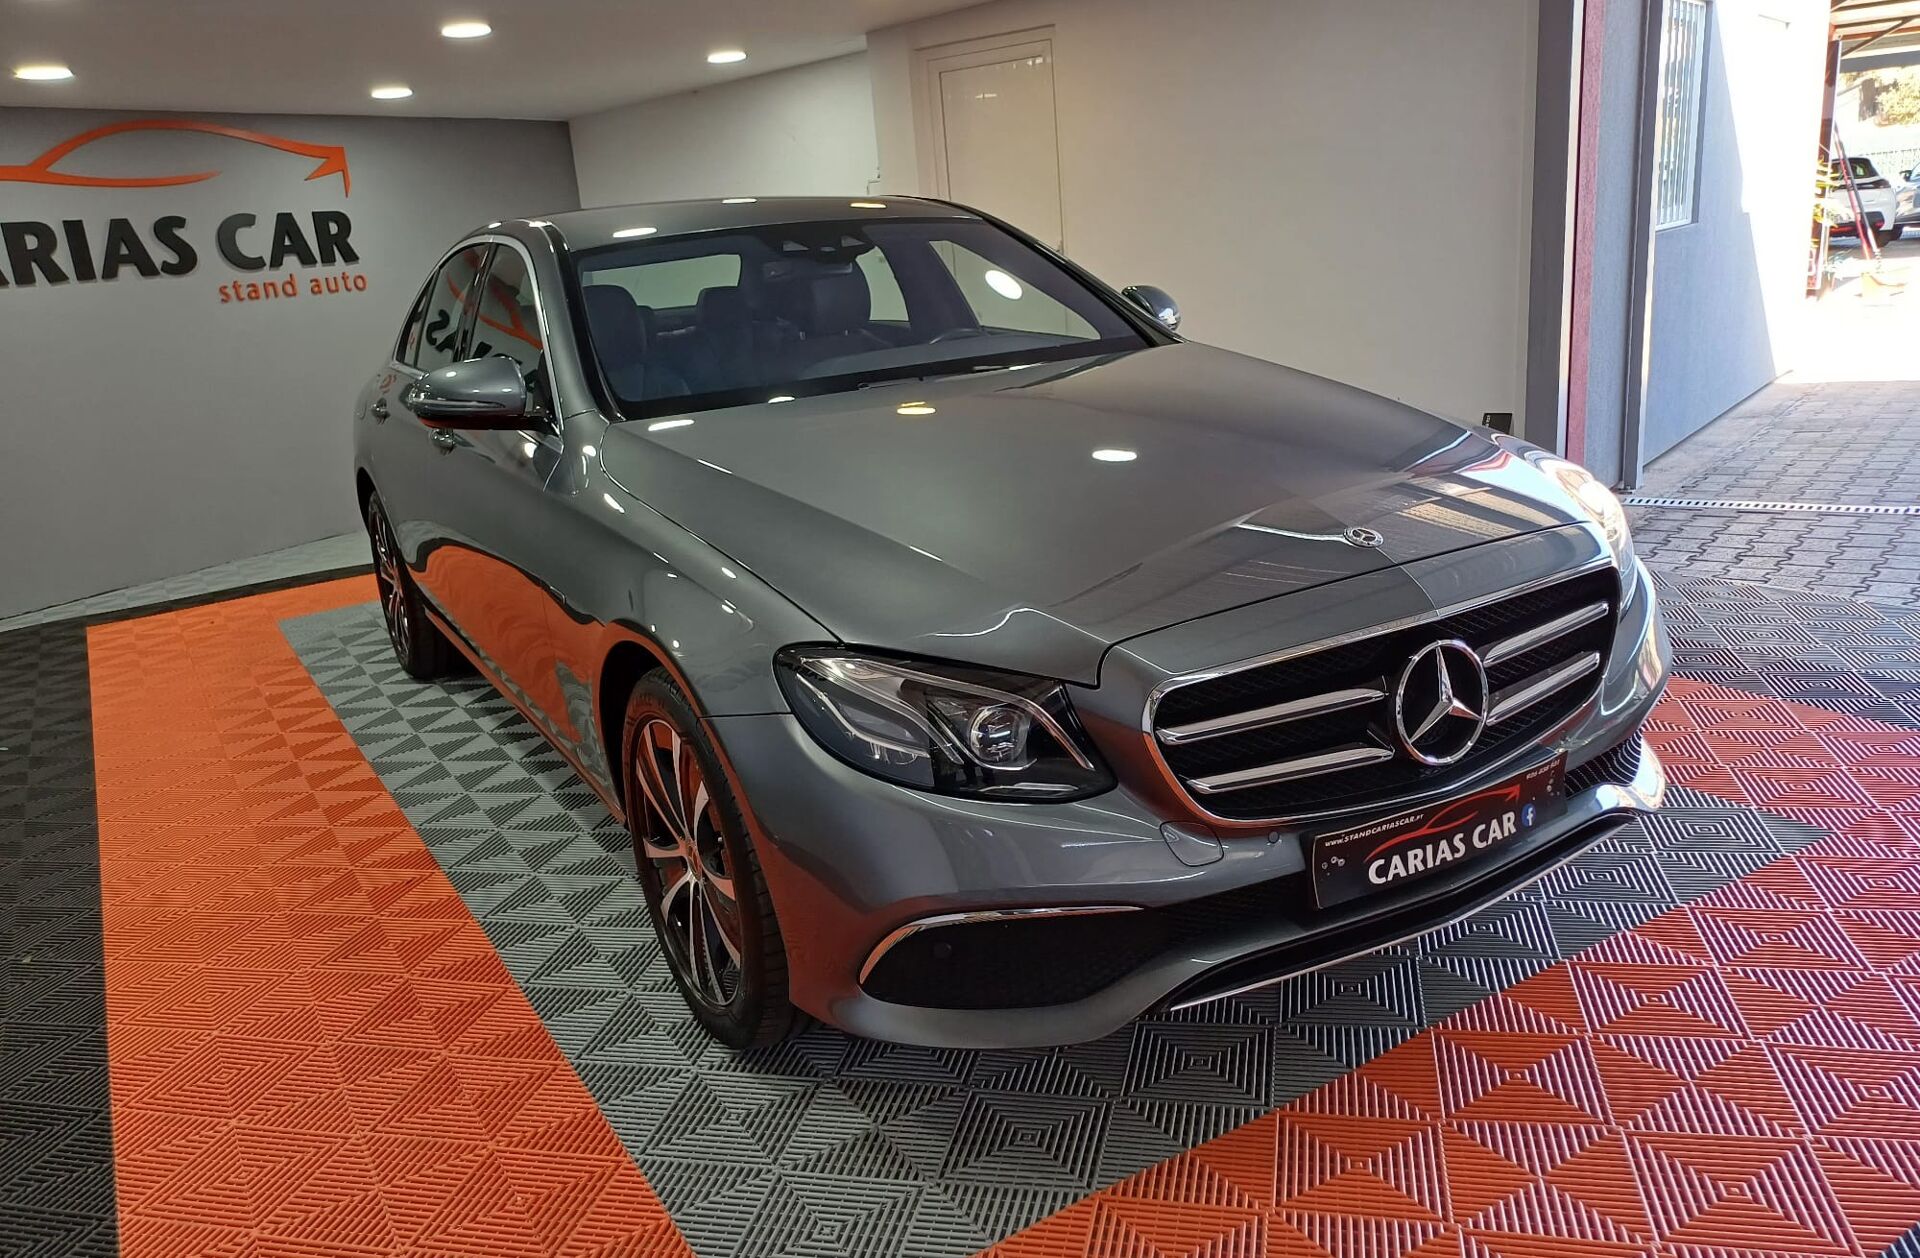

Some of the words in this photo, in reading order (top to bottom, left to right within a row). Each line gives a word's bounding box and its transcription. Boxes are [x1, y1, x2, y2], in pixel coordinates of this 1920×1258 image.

[0, 215, 198, 286] RIAS
[217, 210, 360, 269] CAR
[219, 273, 299, 303] stand
[309, 271, 368, 295] auto
[1368, 833, 1464, 885] CARIAS
[1472, 811, 1517, 849] CAR
